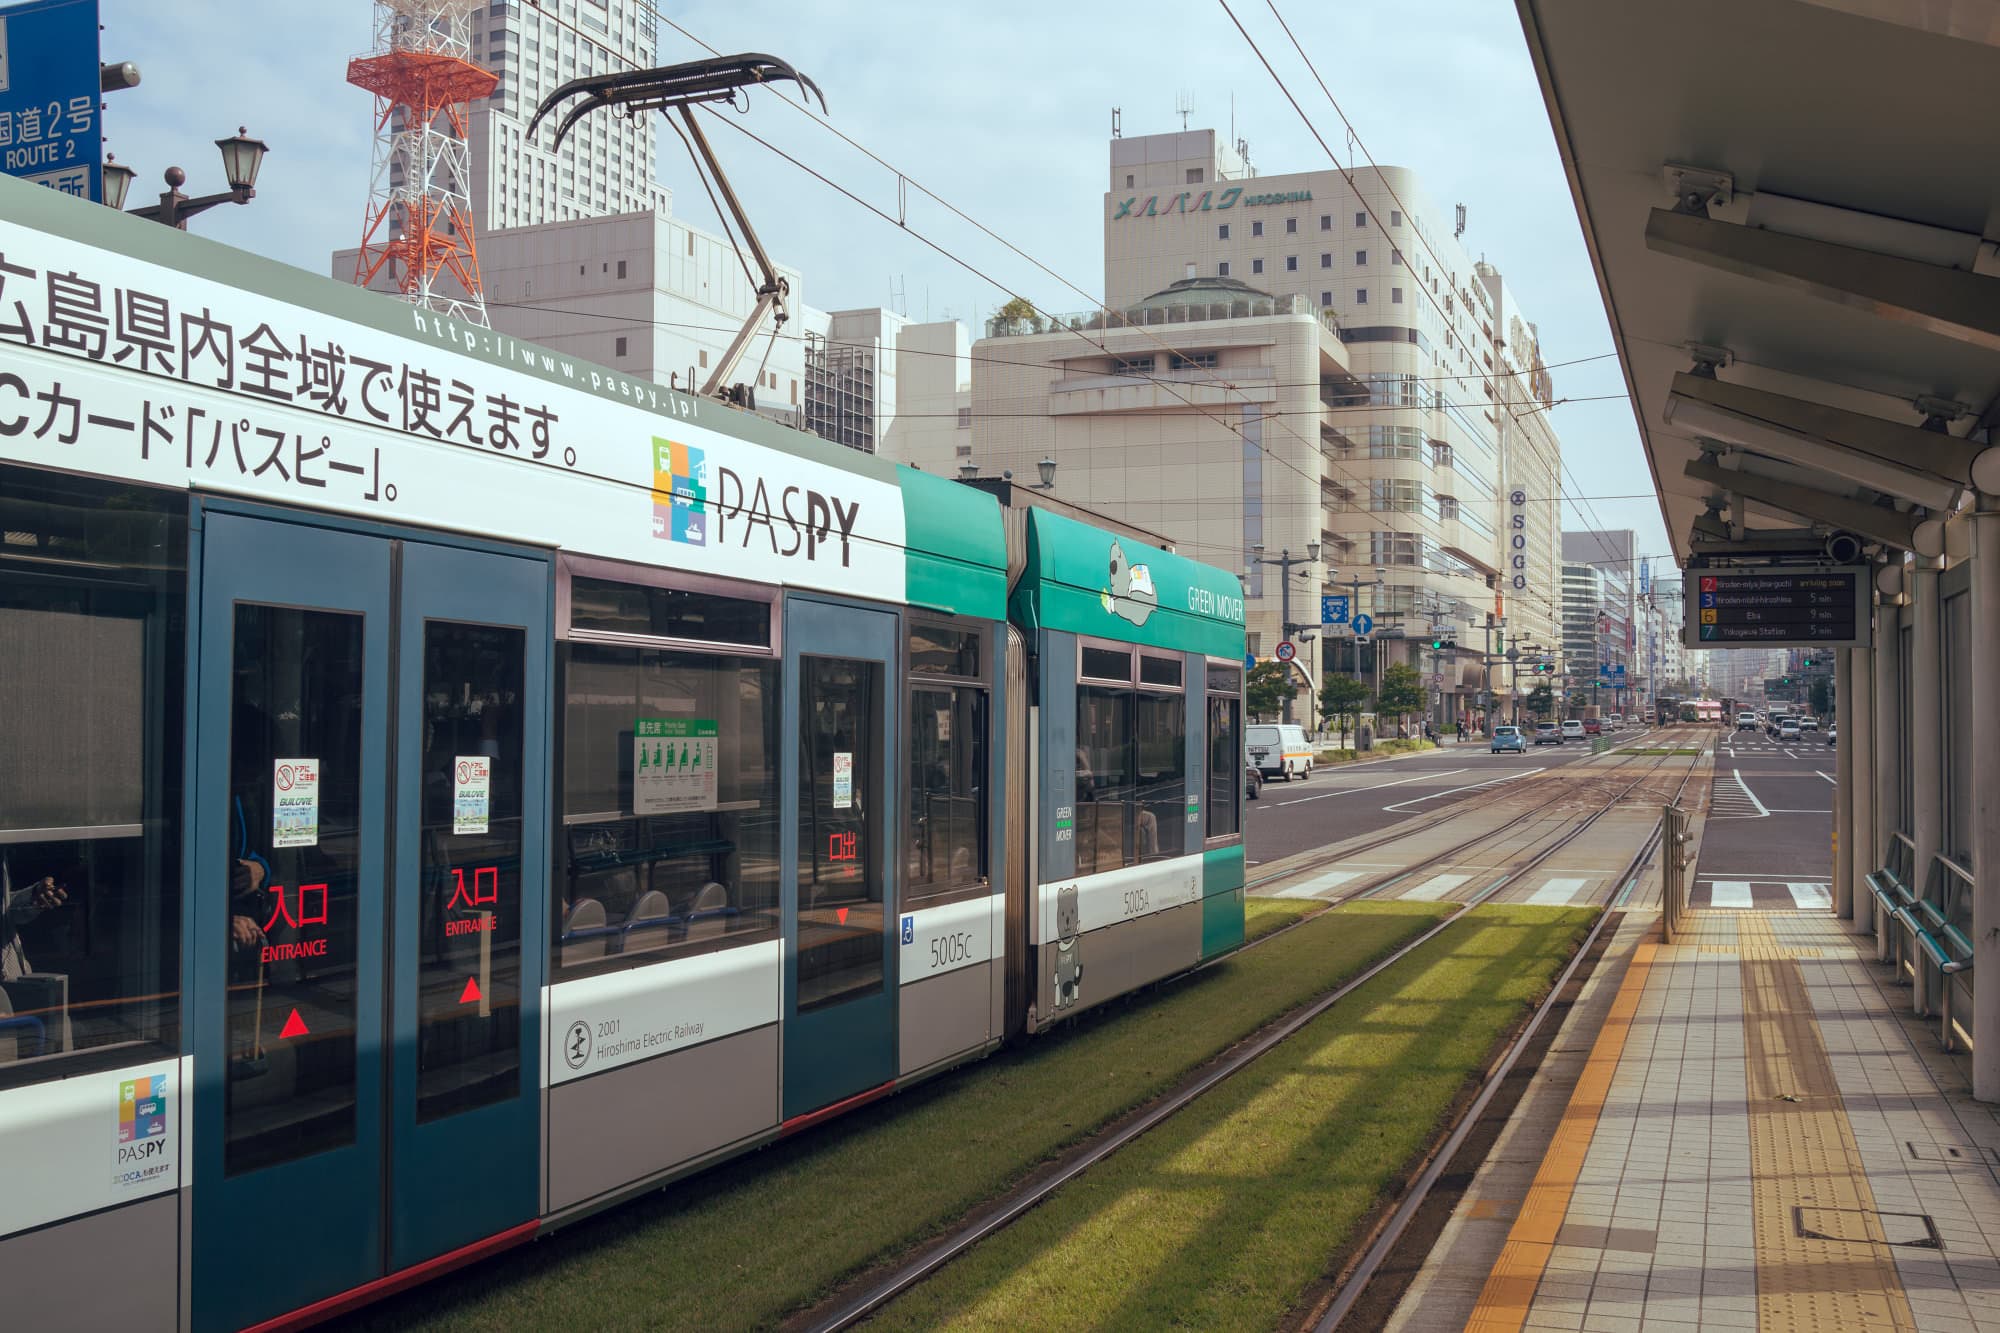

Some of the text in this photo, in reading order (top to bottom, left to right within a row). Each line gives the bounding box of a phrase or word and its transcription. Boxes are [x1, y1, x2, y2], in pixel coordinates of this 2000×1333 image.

[0, 96, 94, 146] 国道2号
[6, 139, 76, 170] ROUTE 2
[1113, 188, 1313, 220] メルパルク HIROSHIMA
[718, 466, 860, 568] PASPY
[1512, 514, 1526, 590] SOGO
[1703, 577, 1713, 592] 2
[1188, 586, 1243, 622] GREEN MOVER
[1704, 593, 1713, 608] 3
[1810, 592, 1817, 603] 5
[1705, 609, 1713, 622] 6
[1810, 608, 1817, 619] 9
[1703, 625, 1713, 639] 7
[1810, 624, 1817, 635] 5
[1056, 806, 1073, 819] GREEN
[447, 866, 498, 910] 入口
[1124, 888, 1150, 915] 5005A
[263, 883, 328, 933] 入口
[446, 915, 497, 937] ENTRANCE
[261, 939, 328, 963] ENTRANCE
[931, 932, 973, 968] 5005C
[597, 1021, 705, 1060] Hiroshima Electric Railway
[598, 1019, 621, 1038] 2001
[118, 1138, 166, 1165] PASPY
